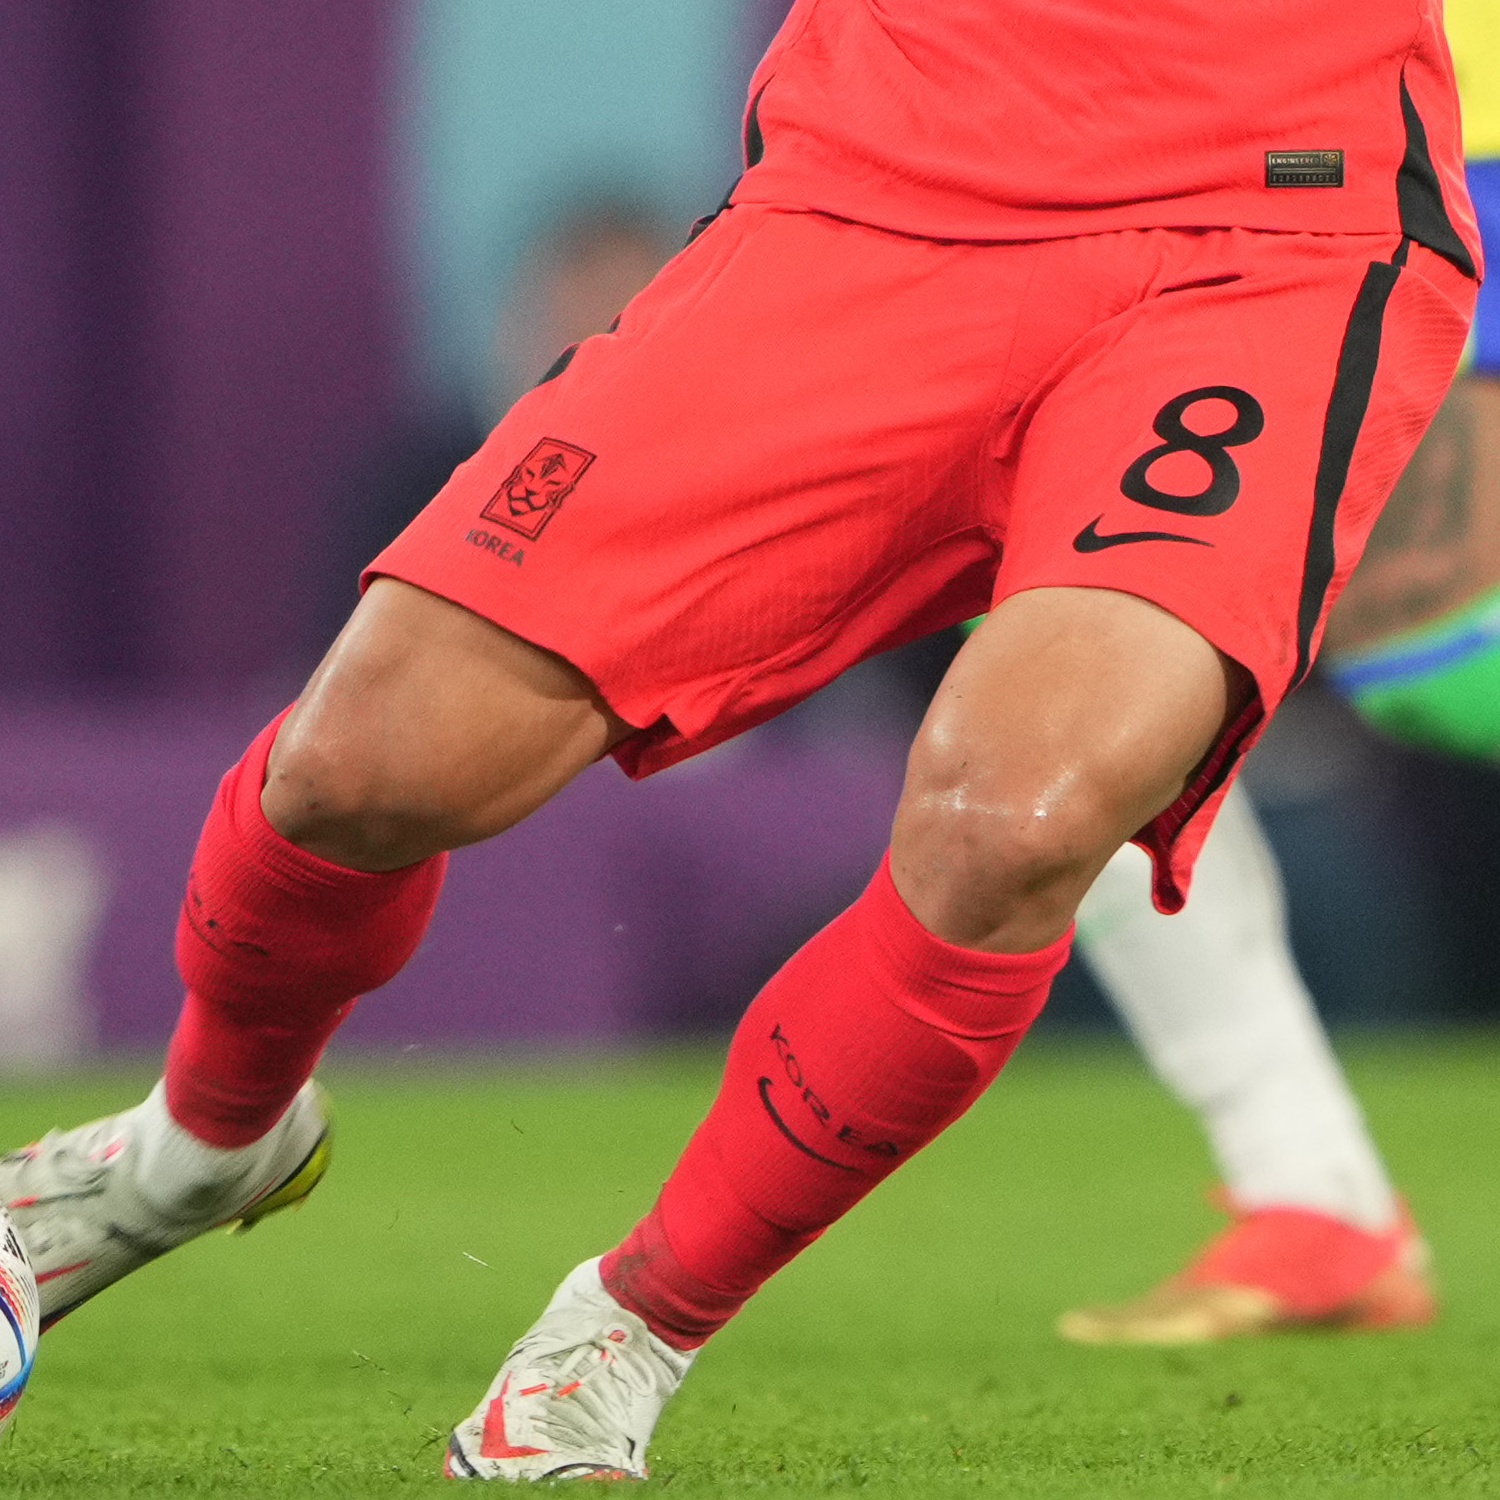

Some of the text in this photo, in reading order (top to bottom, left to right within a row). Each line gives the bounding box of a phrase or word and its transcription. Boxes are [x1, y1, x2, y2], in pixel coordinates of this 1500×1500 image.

[1121, 385, 1264, 516] 8
[464, 528, 525, 567] KOREA
[769, 1023, 900, 1158] KOREA
